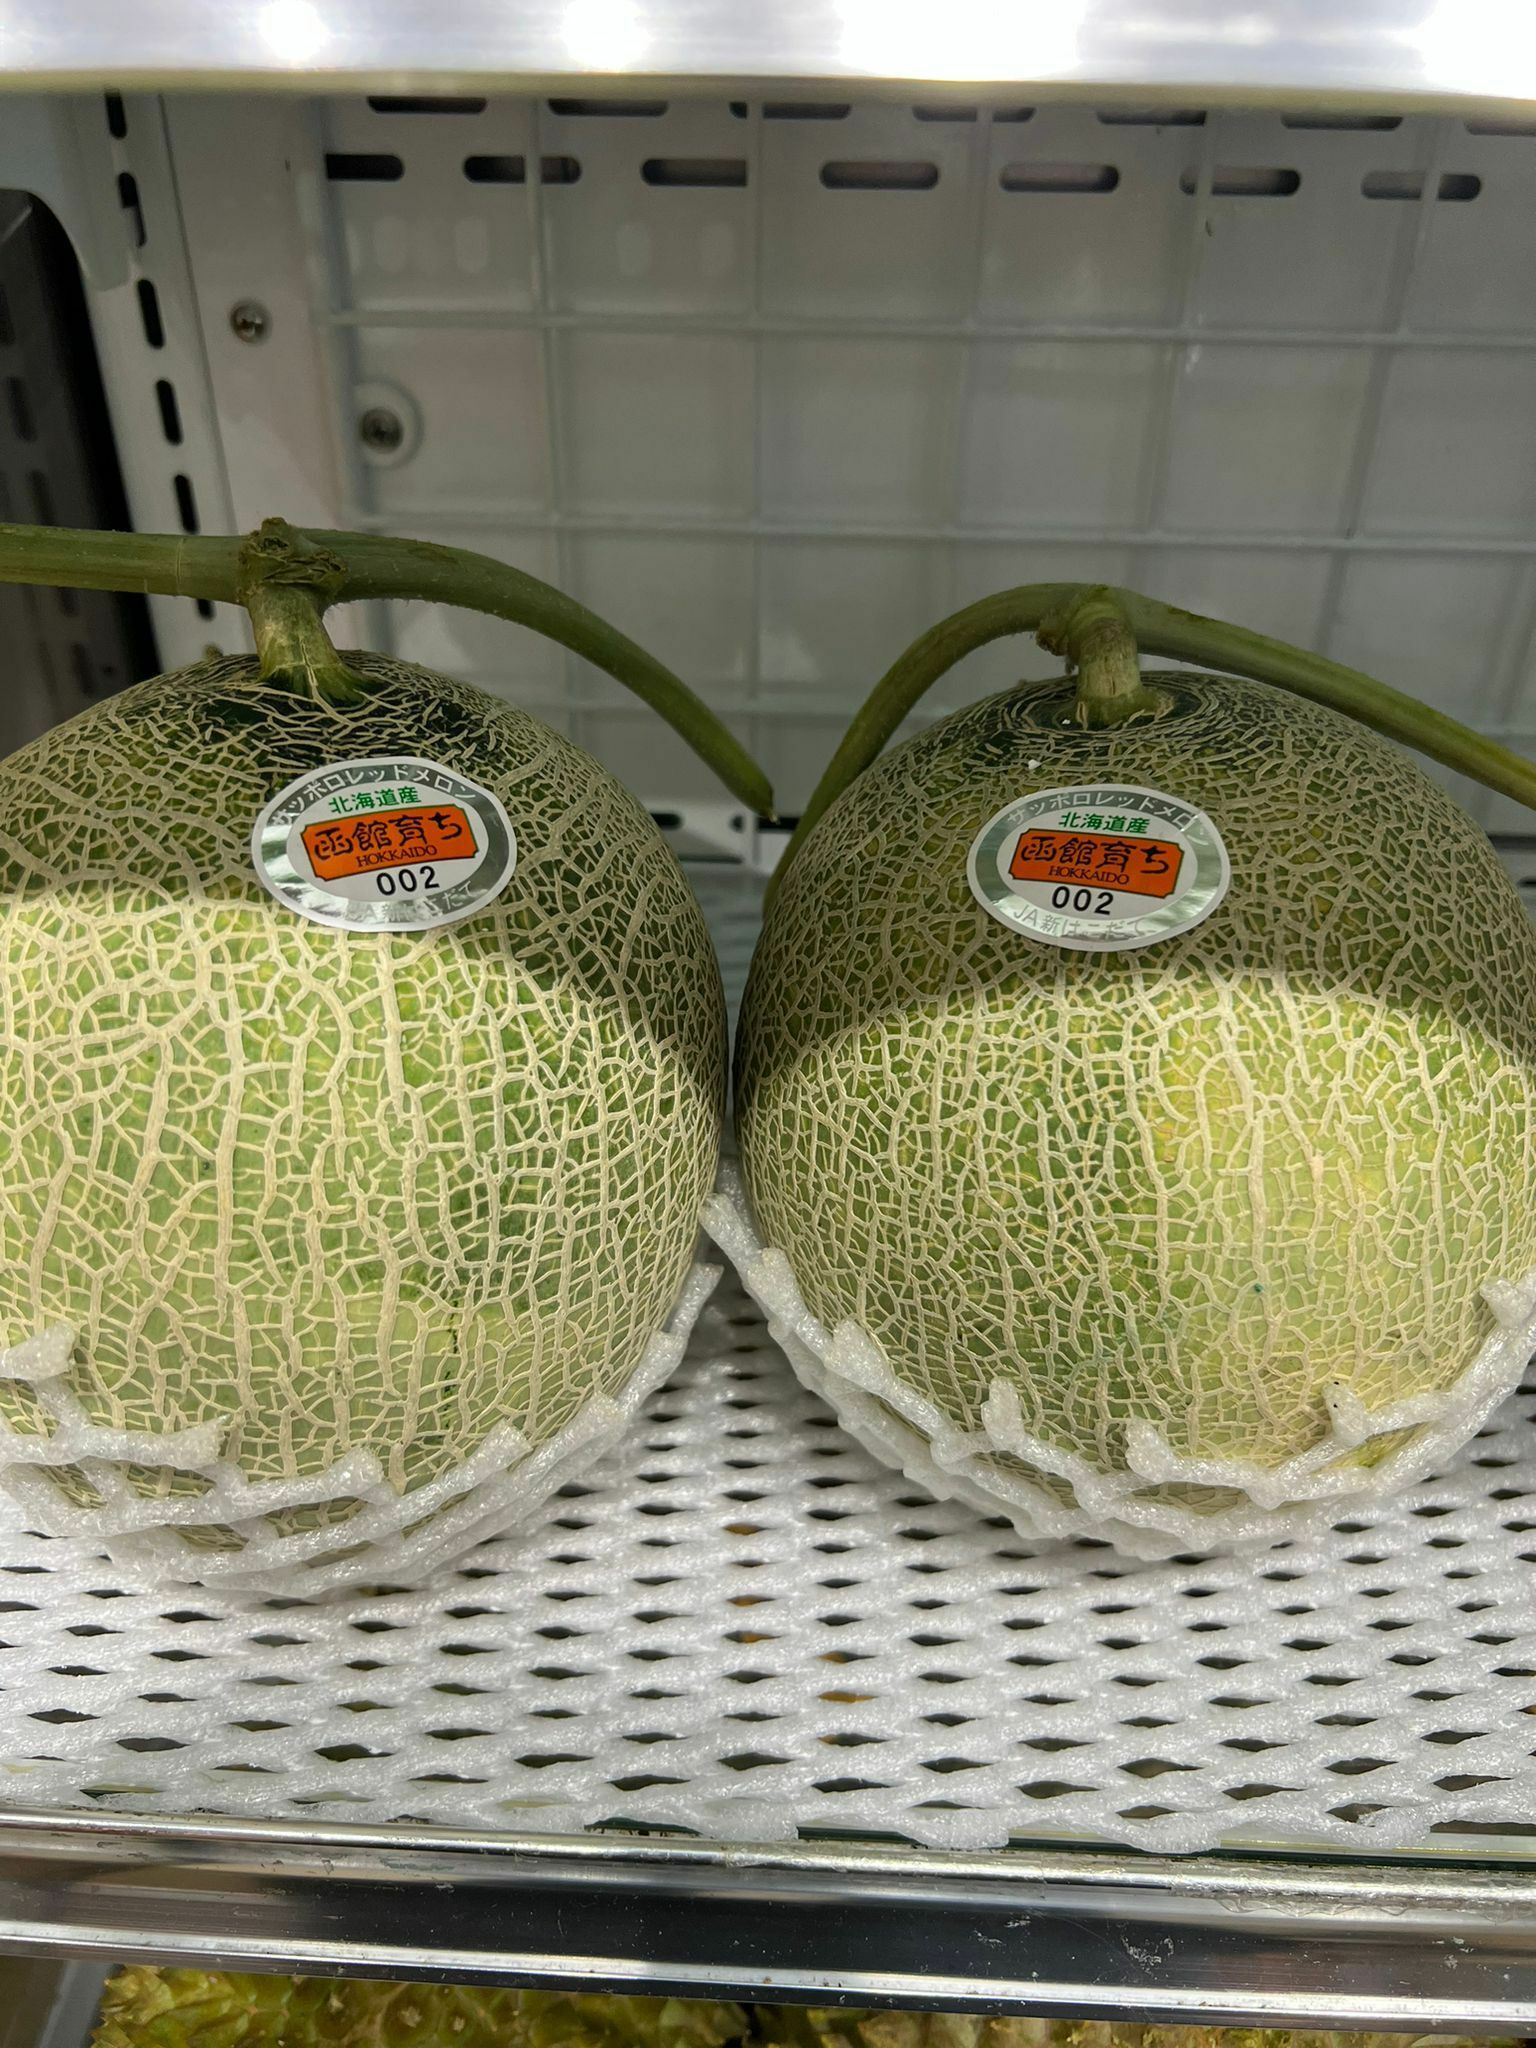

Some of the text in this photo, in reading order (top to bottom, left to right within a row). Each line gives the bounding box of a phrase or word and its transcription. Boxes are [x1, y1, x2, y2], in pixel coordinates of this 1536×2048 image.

[329, 786, 422, 815] 北海道産
[314, 811, 463, 860] 函館育ち
[1058, 811, 1150, 834] 北海道産
[355, 845, 438, 867] HOKKAIDO
[1020, 836, 1170, 875] 函館育ち
[376, 865, 440, 896] 002
[1048, 865, 1130, 885] HOKKAIDO
[1051, 886, 1115, 915] 002
